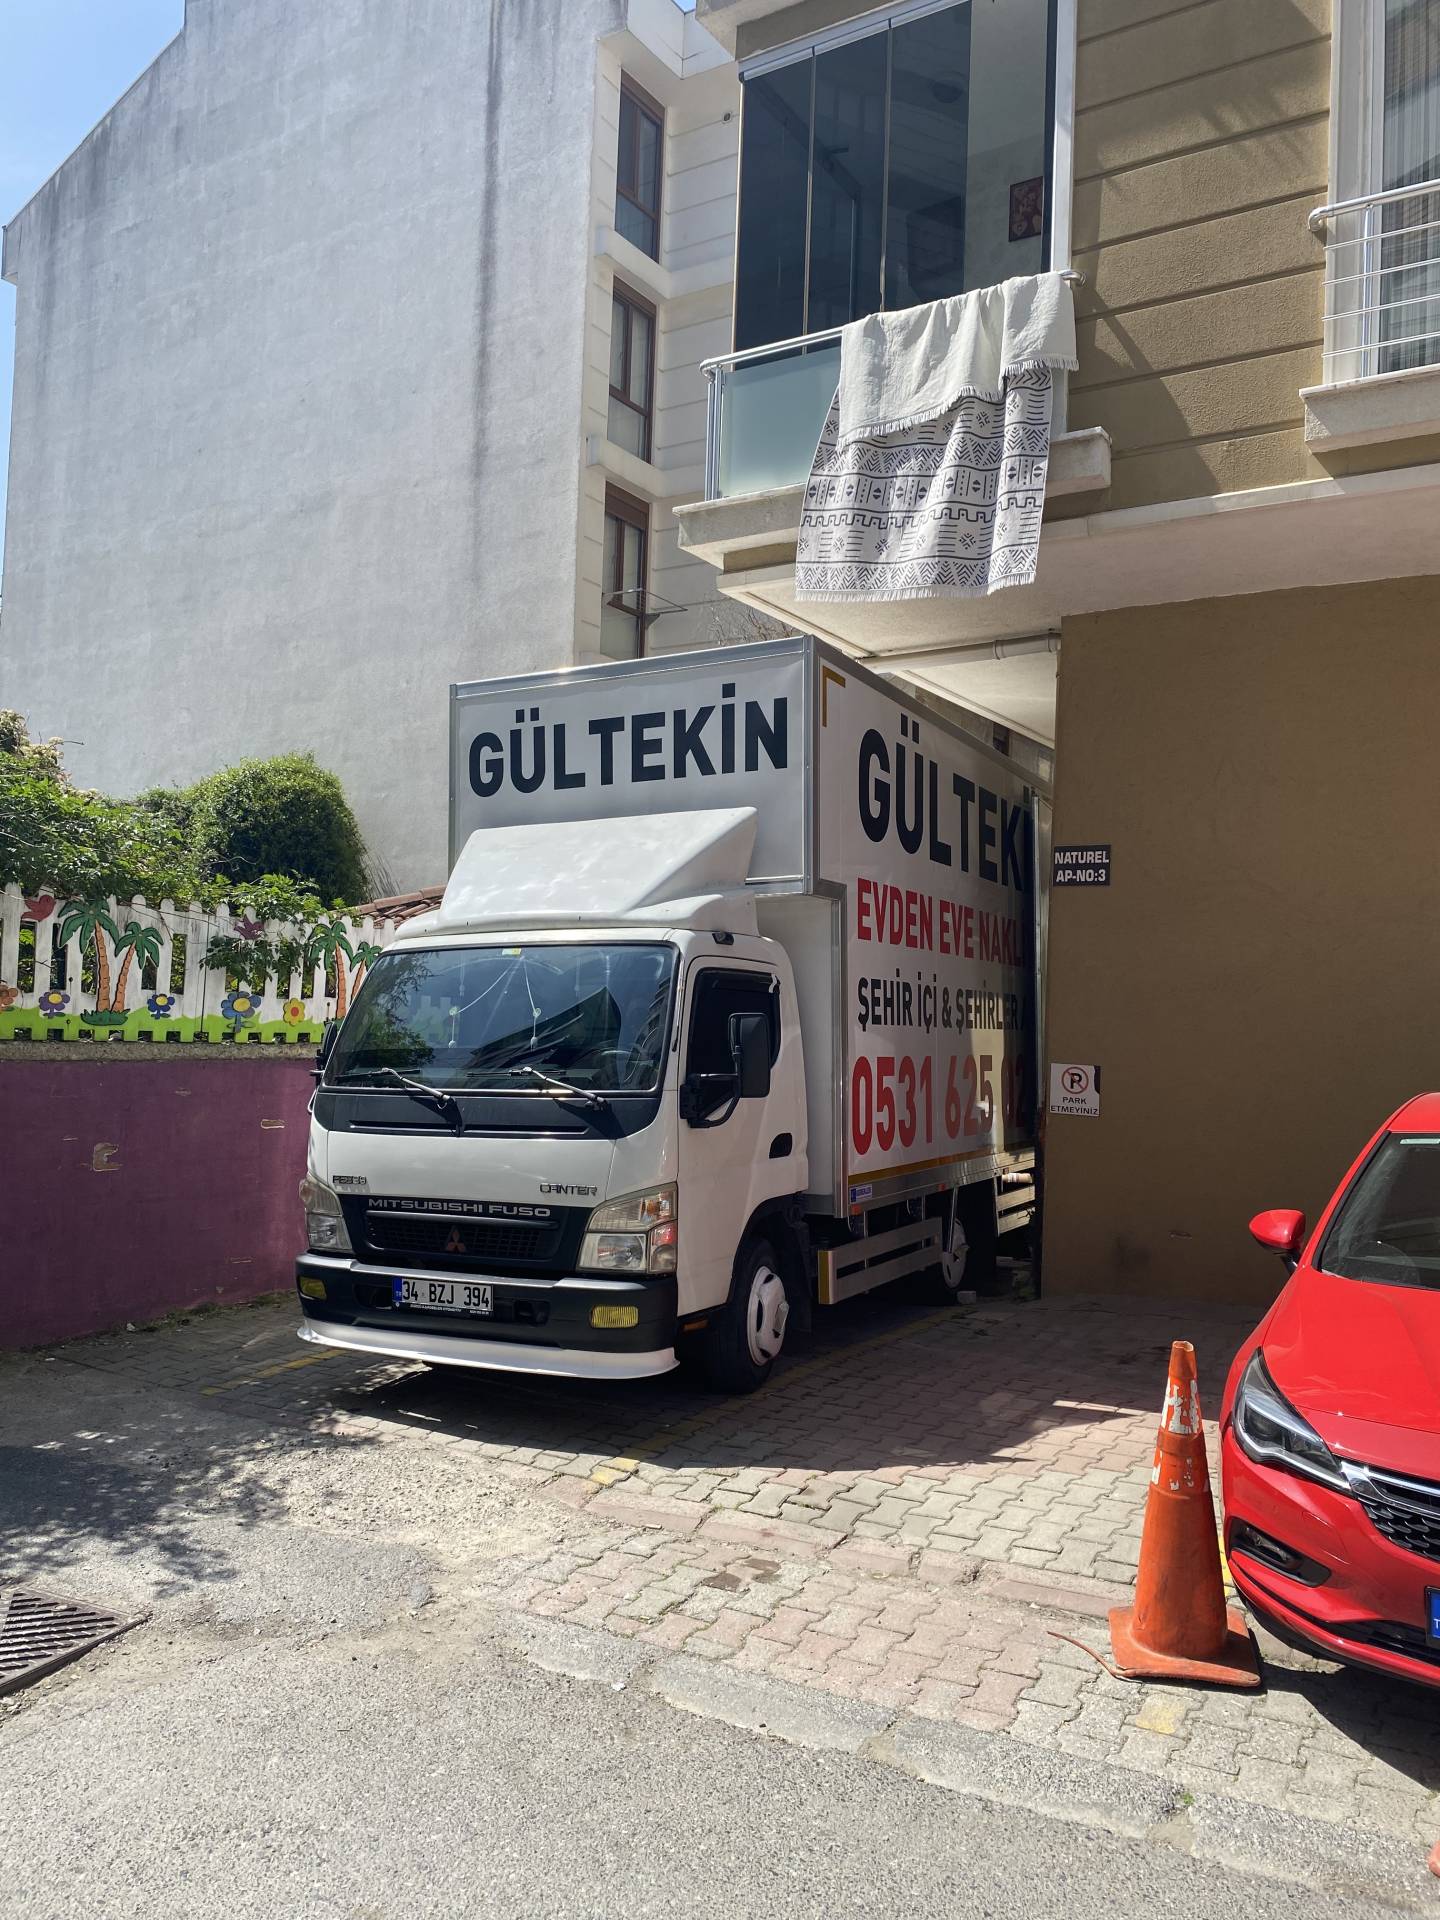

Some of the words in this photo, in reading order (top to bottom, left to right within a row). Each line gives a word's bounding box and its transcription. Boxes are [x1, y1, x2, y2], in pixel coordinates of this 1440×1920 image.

[468, 682, 788, 797] GÜLTEKİN
[858, 712, 1034, 900] GÜLTEKİ
[1054, 850, 1110, 865] NATUREL
[1055, 869, 1106, 882] AP-NO:3
[857, 877, 933, 951] EVDEN
[939, 899, 974, 959] EVE
[978, 909, 1025, 967] NAKL
[857, 968, 913, 1032] ŞEHİR
[917, 971, 937, 1034] İÇİ
[941, 986, 952, 1029] &
[852, 1055, 933, 1155] 0531
[944, 1054, 993, 1140] 625
[1062, 1096, 1087, 1105] PARK
[540, 1183, 598, 1196] CANTER
[368, 1198, 483, 1213] MITSUBISHI
[488, 1205, 551, 1217] FUSO
[402, 1281, 419, 1300] 34
[429, 1283, 455, 1304] BZJ
[463, 1286, 490, 1307] 394
